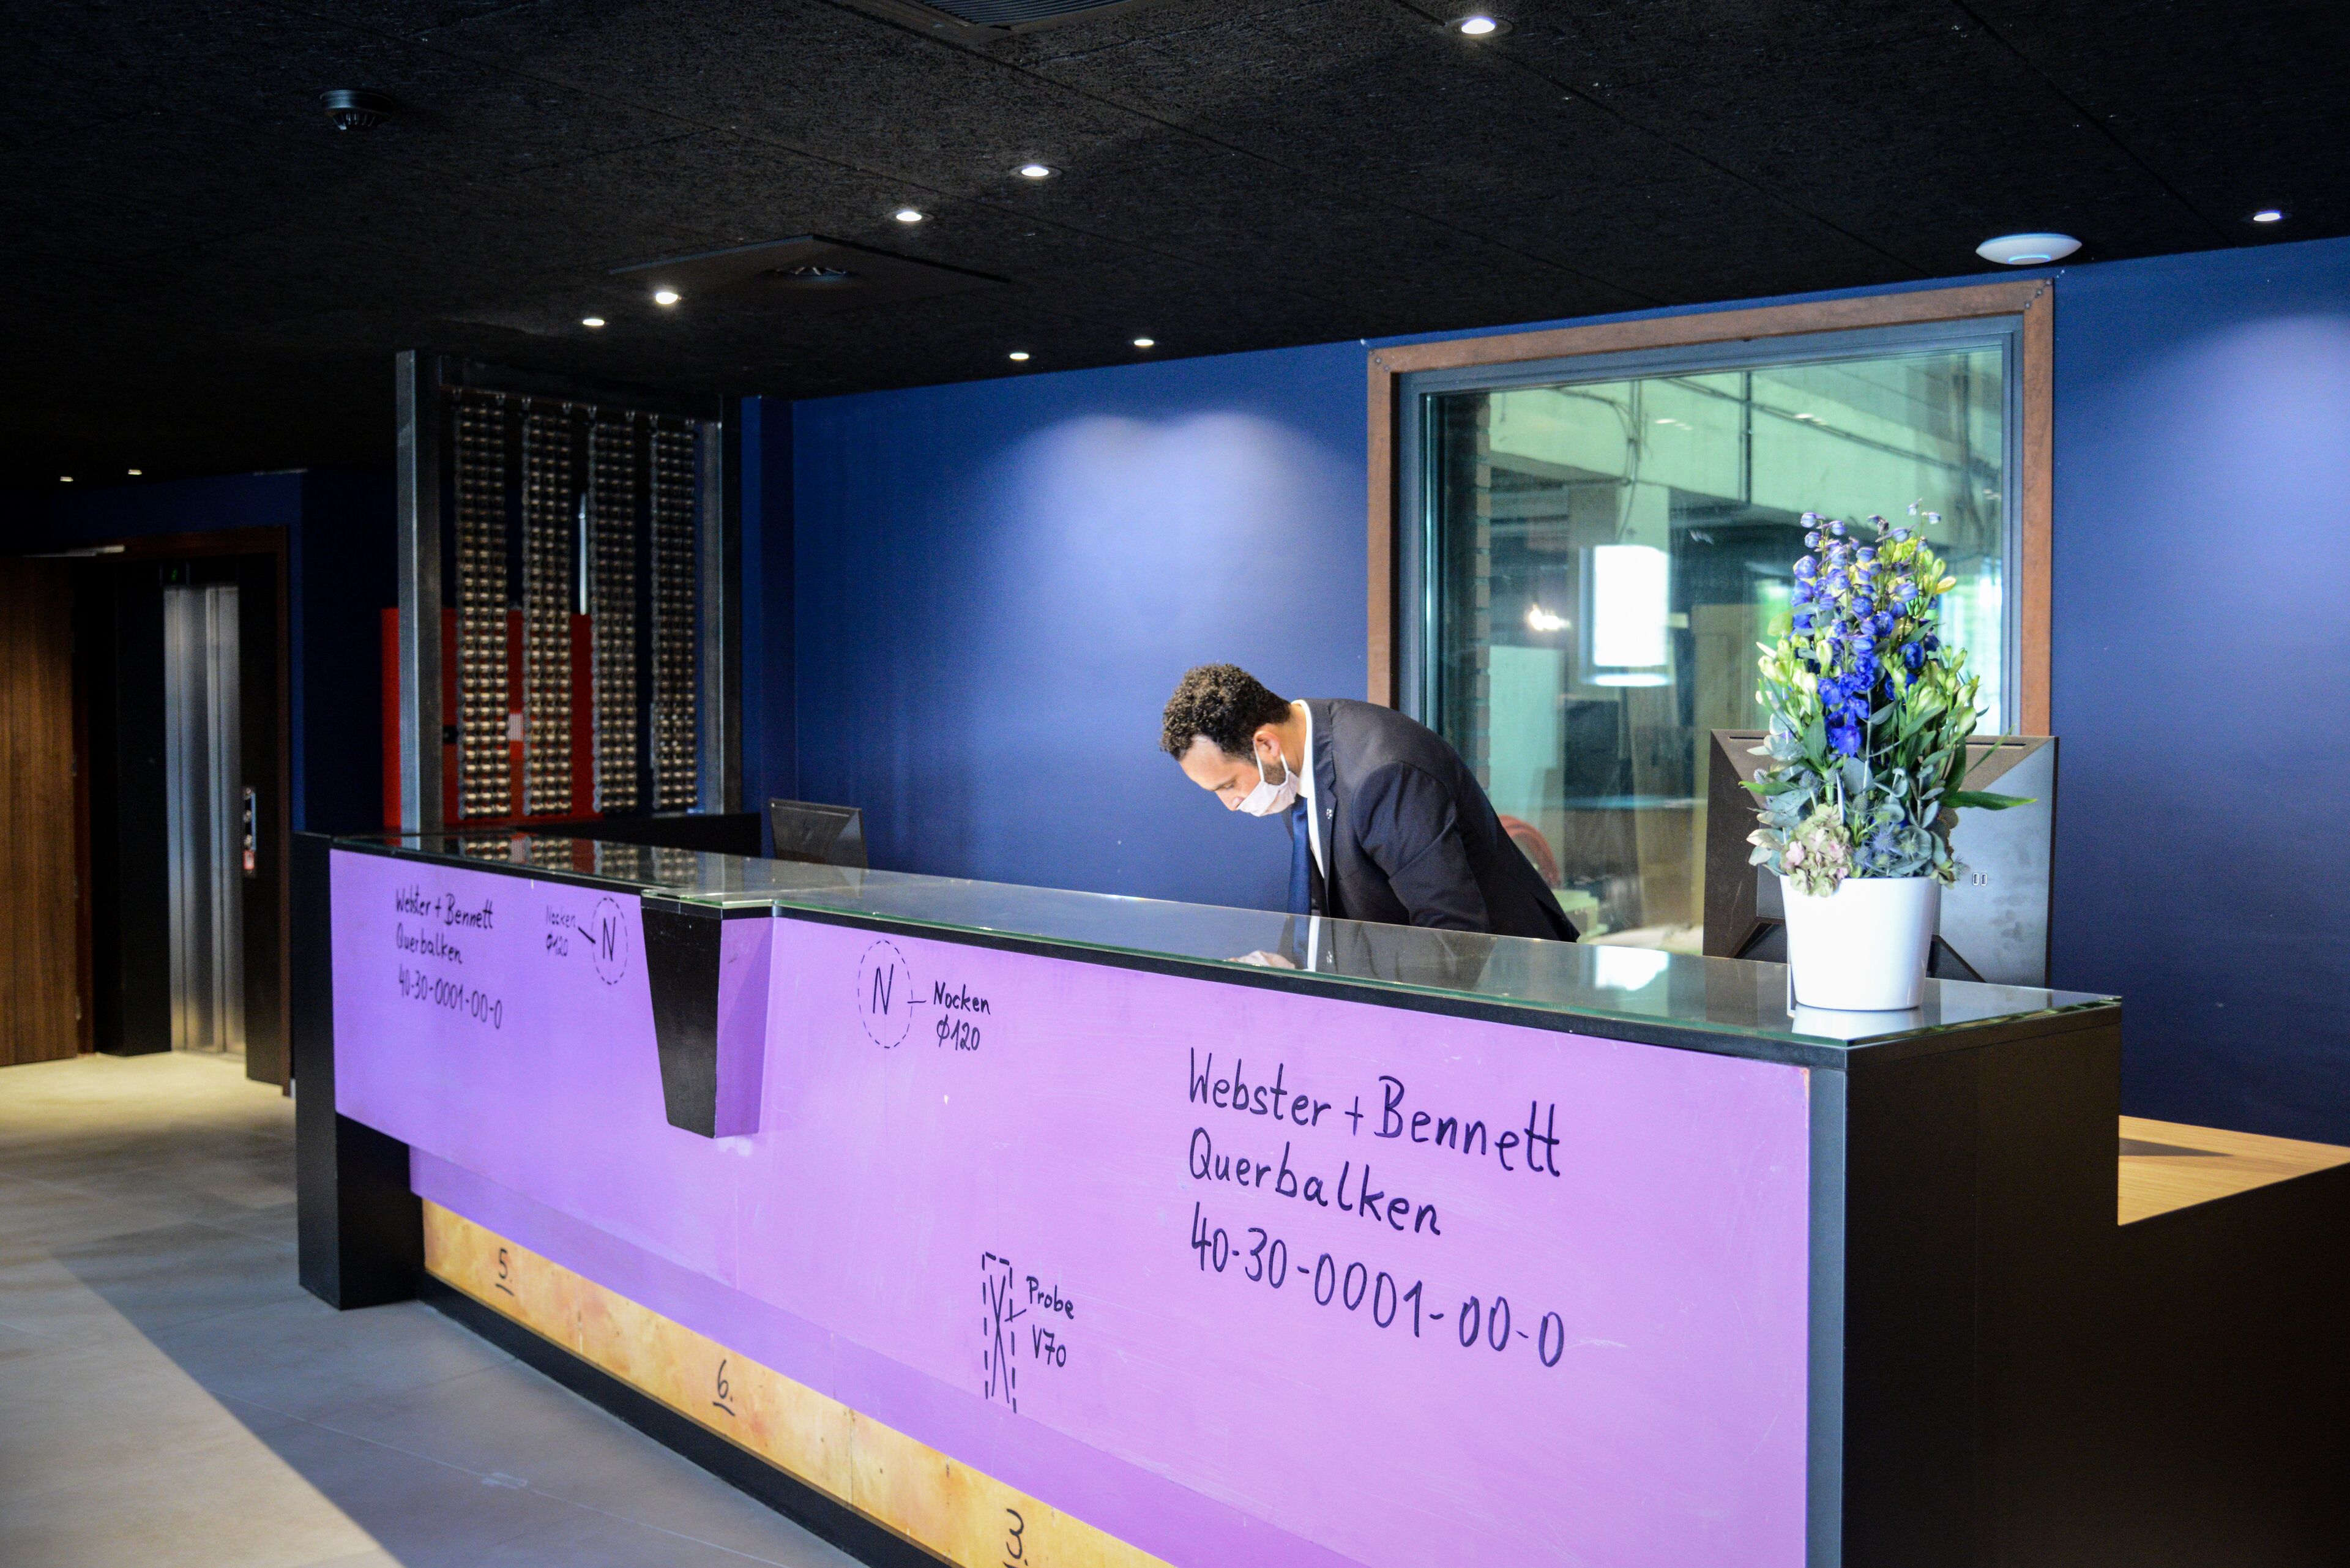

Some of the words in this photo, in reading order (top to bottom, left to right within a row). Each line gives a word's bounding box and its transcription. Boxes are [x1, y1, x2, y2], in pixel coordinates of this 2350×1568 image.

[396, 884, 431, 916] Webster
[435, 897, 442, 917] +
[444, 893, 493, 929] Bennett
[397, 922, 463, 965] Querbalken
[603, 917, 616, 962] N
[399, 963, 502, 1029] 40-30-0001-00-0
[873, 963, 894, 1015] N
[933, 980, 991, 1015] Nocken
[1190, 1047, 1331, 1126] Webster
[1345, 1096, 1364, 1136] +
[1374, 1075, 1561, 1176] Bennett
[1190, 1127, 1441, 1235] Querbalken
[1026, 1275, 1074, 1320] Probe
[1192, 1201, 1565, 1367] 40-30-0001-00-0
[1032, 1324, 1067, 1367] V70
